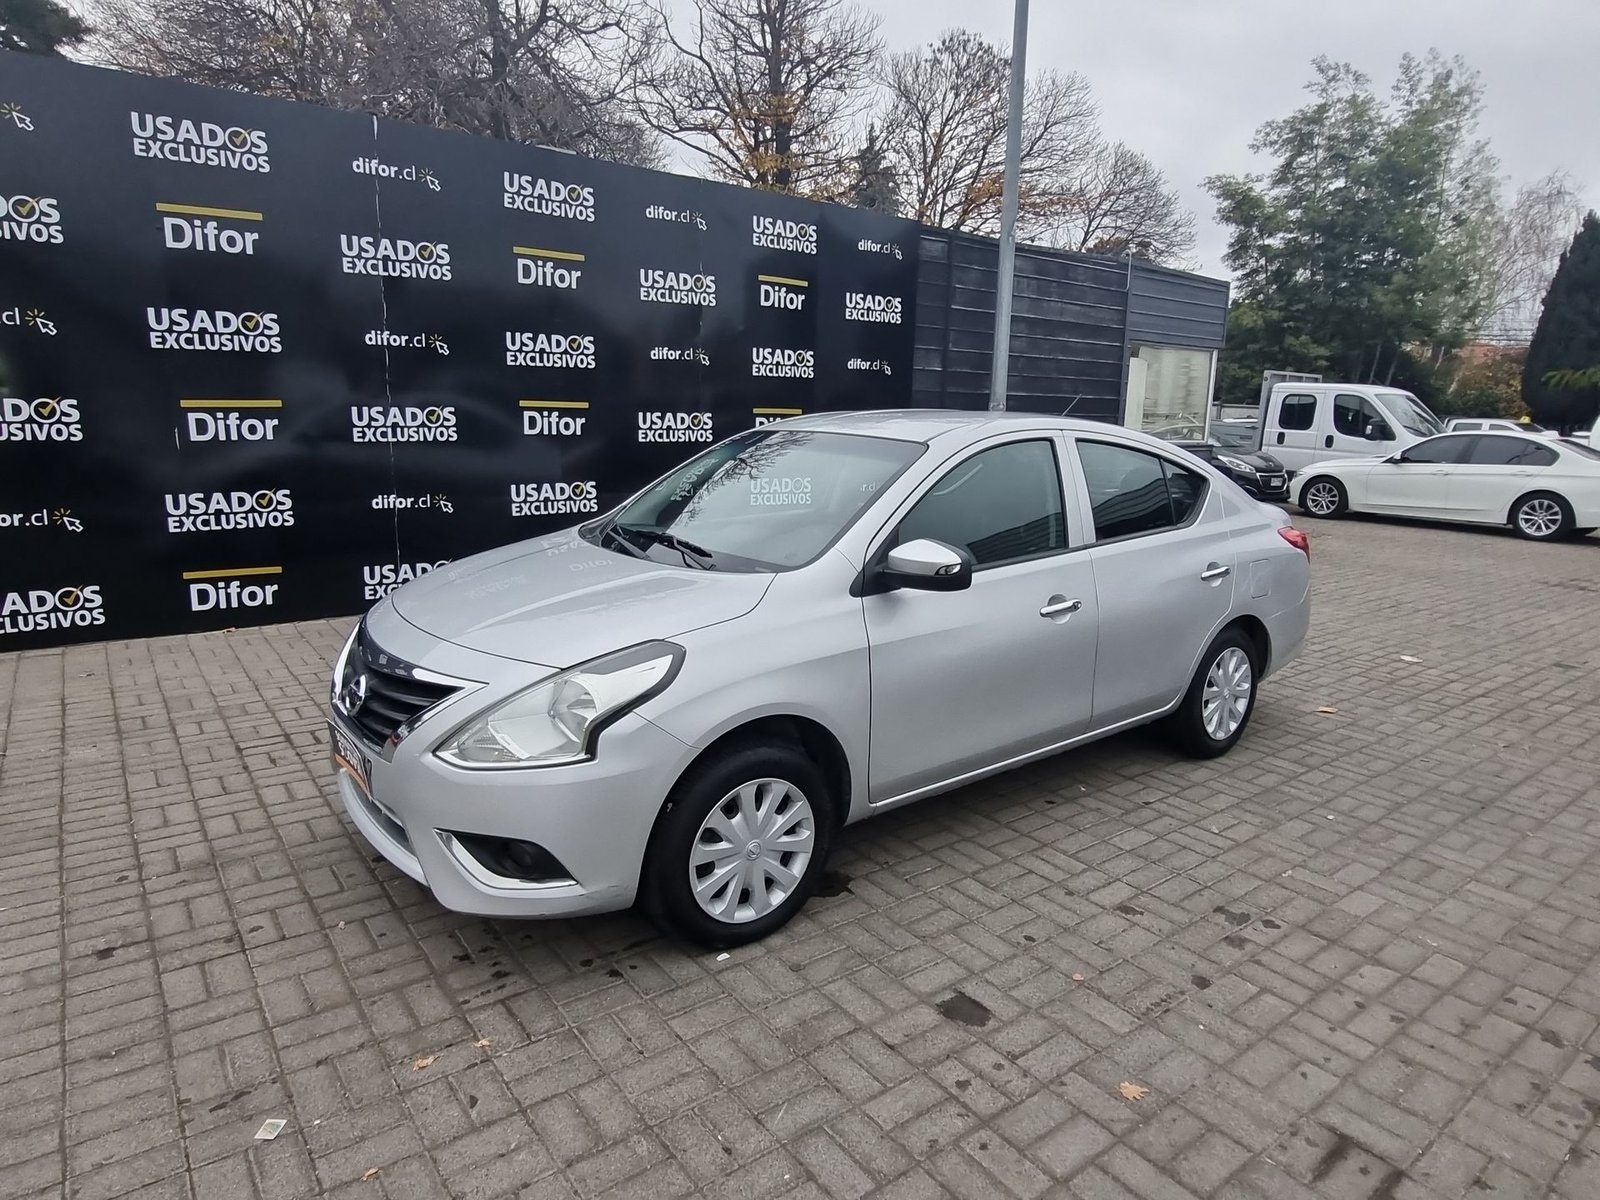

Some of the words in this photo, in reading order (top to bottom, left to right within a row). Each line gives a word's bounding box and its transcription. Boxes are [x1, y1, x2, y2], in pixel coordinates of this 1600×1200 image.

[131, 112, 268, 154] USADOS
[133, 138, 270, 173] EXCLUSIVOS
[352, 157, 416, 181] difor.cl
[504, 171, 594, 206] USADOS
[0, 195, 60, 223] OS
[504, 193, 595, 222] EXCLUSIVOS
[645, 205, 690, 223] difor.cl
[0, 221, 64, 243] IVOS
[163, 217, 259, 254] Difor
[752, 216, 817, 242] USADOS
[340, 234, 450, 264] USADOS
[753, 233, 817, 254] EXCLUSIVOS
[858, 239, 891, 254] difor.cl
[342, 257, 451, 281] EXCLUSIVOS
[517, 258, 581, 289] Difor
[640, 268, 716, 292] USADOS
[640, 287, 716, 307] EXCLUSIVOS
[760, 284, 805, 310] Difor
[845, 292, 901, 313] USADOS
[147, 307, 280, 335] USADOS
[845, 307, 901, 324] EXCLUSIVOS
[150, 332, 282, 353] EXCLUSIVOS
[365, 330, 426, 348] difor.cl
[506, 331, 595, 354] USADOS
[506, 351, 596, 369] EXCLUSIVOS
[650, 347, 693, 360] difor.cl
[752, 347, 814, 367] USADOS
[848, 358, 880, 370] difor.cl
[752, 364, 814, 378] EXCLUSIVOS
[0, 398, 80, 423] DOS
[351, 406, 456, 427] USADOS
[638, 412, 713, 430] USADOS
[187, 412, 279, 442] Difor
[523, 410, 586, 436] Difor
[352, 426, 458, 443] EXCLUSIVOS
[638, 429, 713, 442] EXCLUSIVOS
[510, 481, 597, 502] USADOS
[750, 478, 812, 493] USADOS
[165, 489, 292, 516] USADOS
[371, 494, 430, 509] difor.cl
[511, 499, 598, 516] EXCLUSIVOS
[750, 493, 811, 505] EXCLUSIVOS
[167, 511, 294, 533] EXCLUSIVOS
[2, 585, 103, 616] ADOS
[189, 581, 278, 612] Difor
